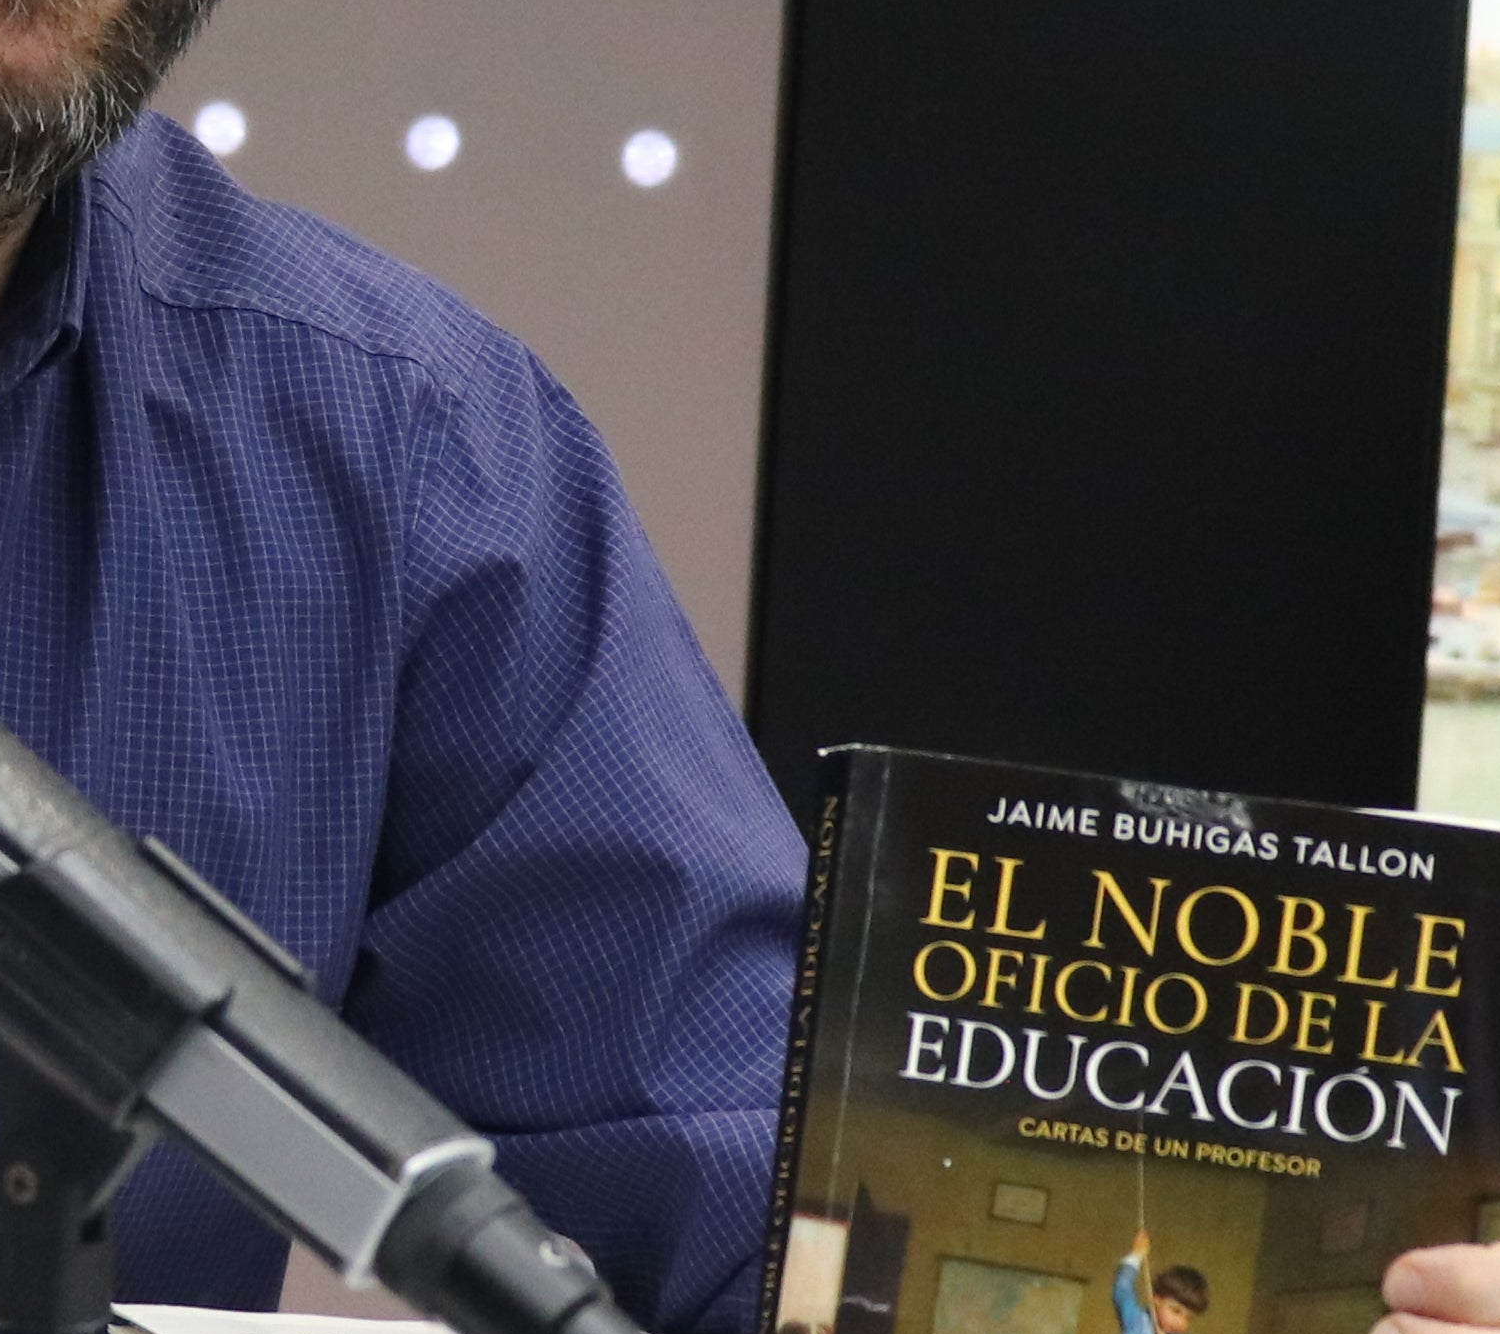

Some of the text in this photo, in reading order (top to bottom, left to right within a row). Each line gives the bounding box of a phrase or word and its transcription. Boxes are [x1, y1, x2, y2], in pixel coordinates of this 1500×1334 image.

[987, 798, 1435, 881] JAIME BUHIGAS TALLON
[918, 847, 1467, 997] EL NOBLE
[913, 939, 1466, 1074] OFICIO DE LA
[899, 1011, 1462, 1157] EDUCACIÓN
[1018, 1117, 1322, 1179] CARTAS DE UN PROFESOR
